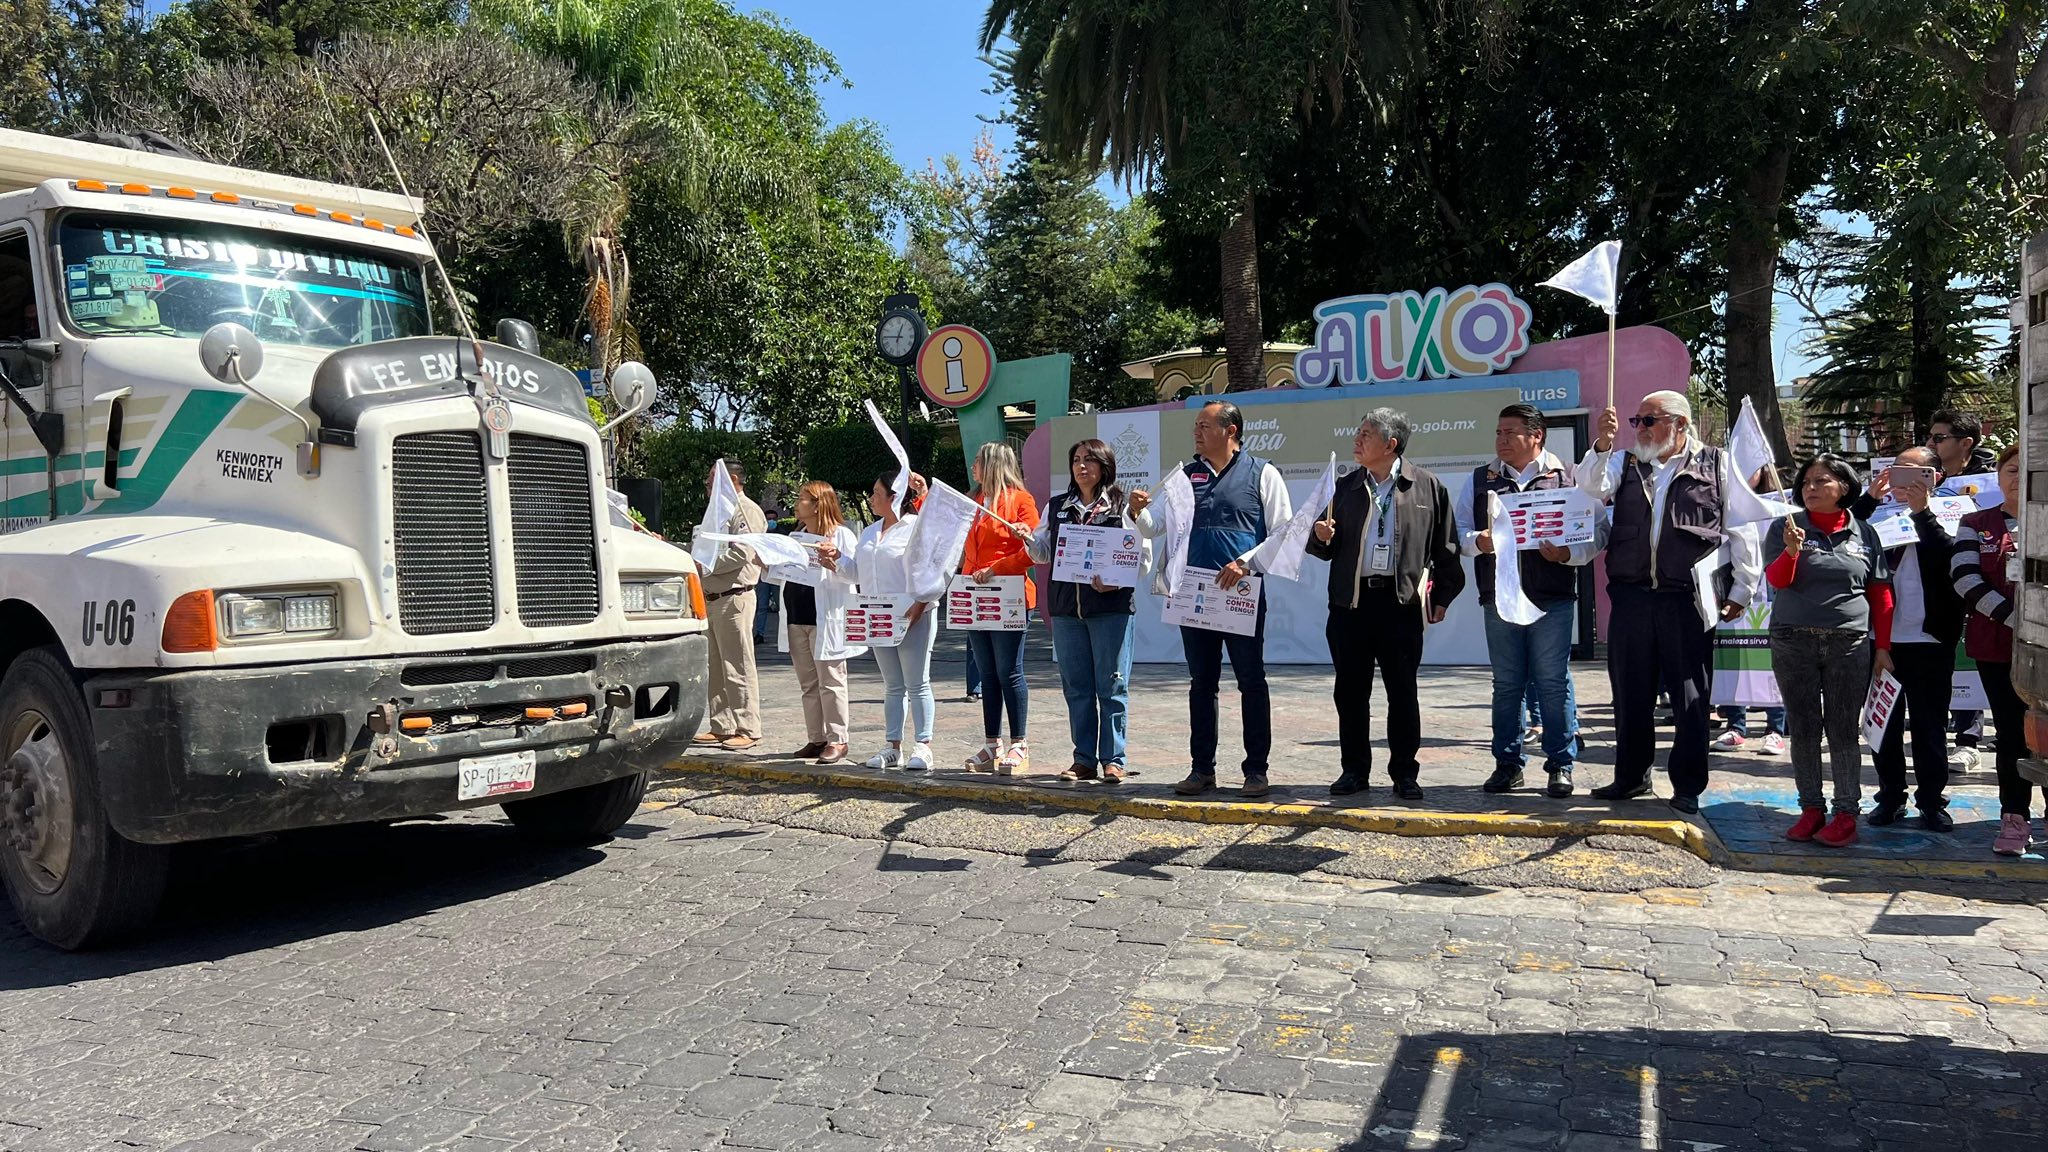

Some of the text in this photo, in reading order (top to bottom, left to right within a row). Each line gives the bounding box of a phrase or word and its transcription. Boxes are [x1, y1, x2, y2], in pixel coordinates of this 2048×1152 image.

[1298, 286, 1528, 387] ATLIXCO
[371, 353, 540, 394] FE EN DIOS
[1242, 418, 1280, 431] iudad,
[216, 448, 283, 470] KENWORTH
[222, 463, 274, 483] KENMEX
[1112, 553, 1138, 561] CONTRA
[1225, 599, 1255, 609] CONTRA
[1230, 606, 1255, 615] DENGUE
[82, 598, 136, 647] U-06
[1720, 637, 1749, 645] maleza
